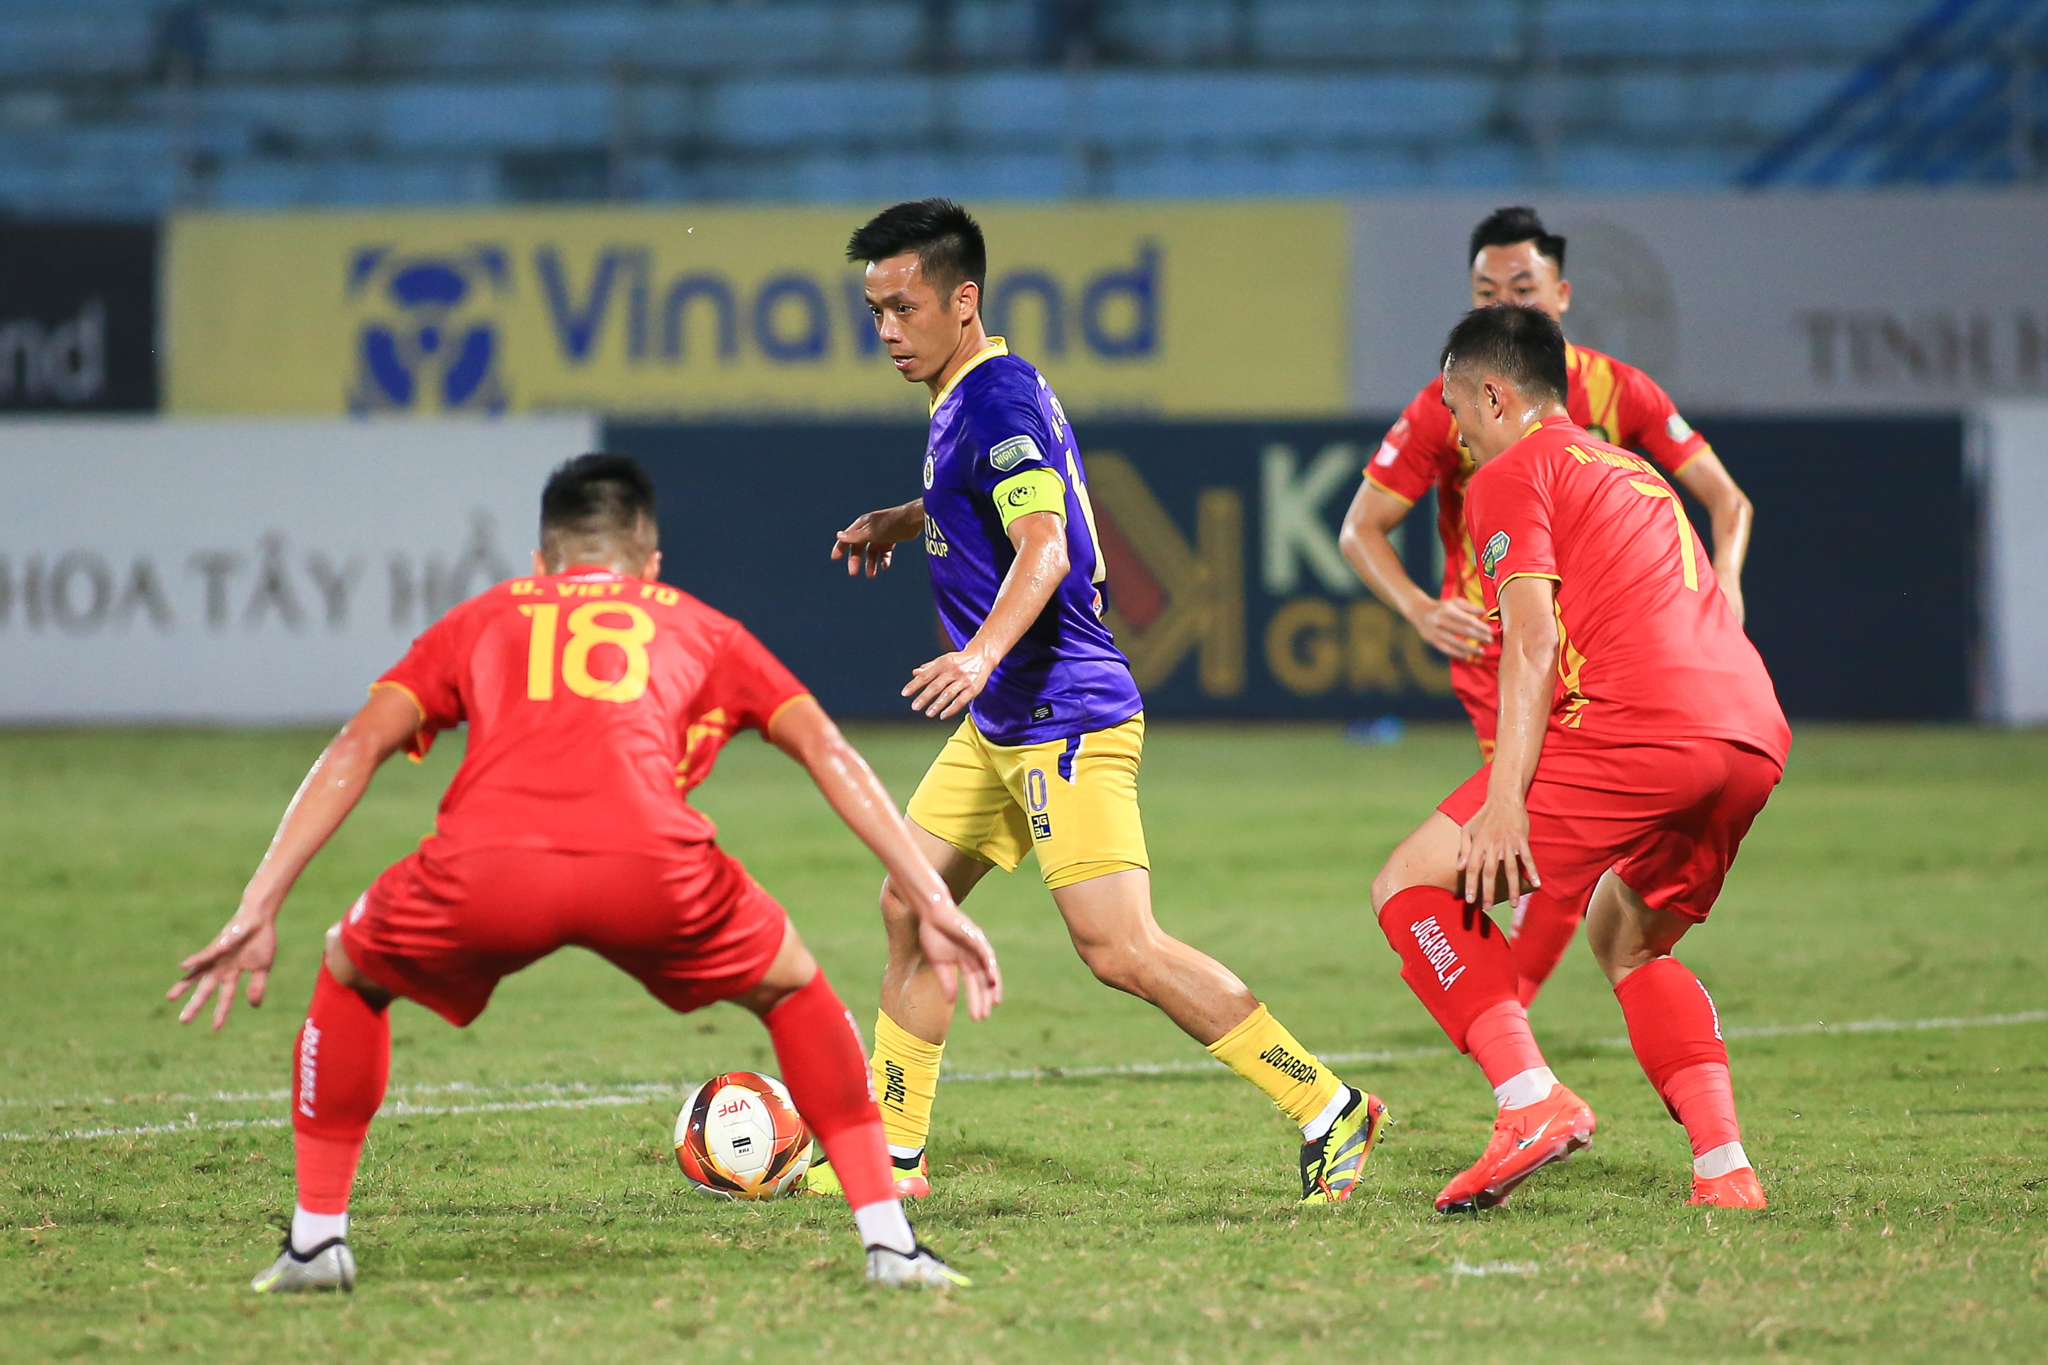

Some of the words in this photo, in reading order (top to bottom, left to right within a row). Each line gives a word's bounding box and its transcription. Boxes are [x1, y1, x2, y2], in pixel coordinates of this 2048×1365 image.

[994, 446, 1018, 466] NIGHT
[1628, 479, 1699, 592] 7
[516, 600, 656, 704] 18
[1409, 915, 1466, 992] JOGARBOLA
[718, 1099, 751, 1118] VPF
